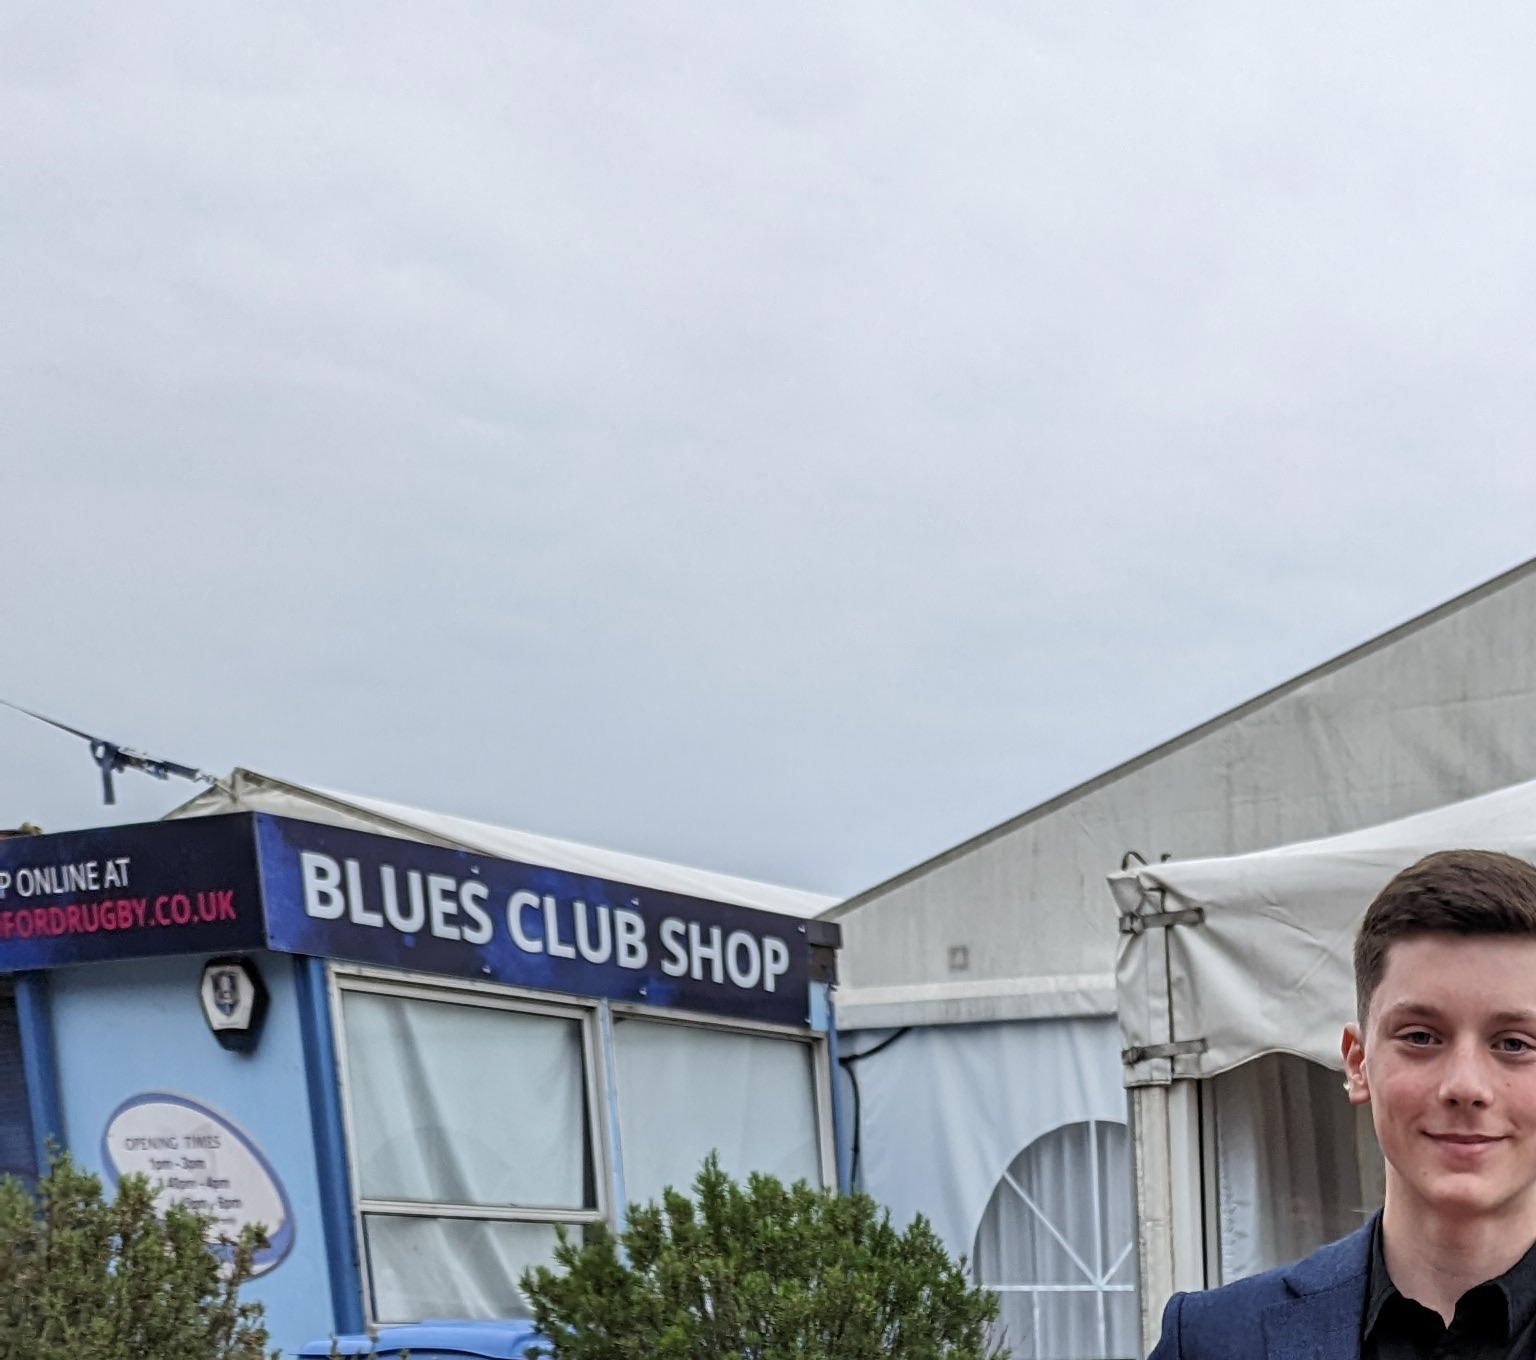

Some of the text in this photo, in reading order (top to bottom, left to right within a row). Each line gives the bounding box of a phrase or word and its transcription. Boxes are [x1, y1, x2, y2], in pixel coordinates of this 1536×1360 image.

[16, 861, 100, 897] ONLINE
[104, 857, 130, 888] AT
[301, 852, 790, 992] BLUES CLUB SHOP
[125, 1136, 221, 1150] OPENING TIMES
